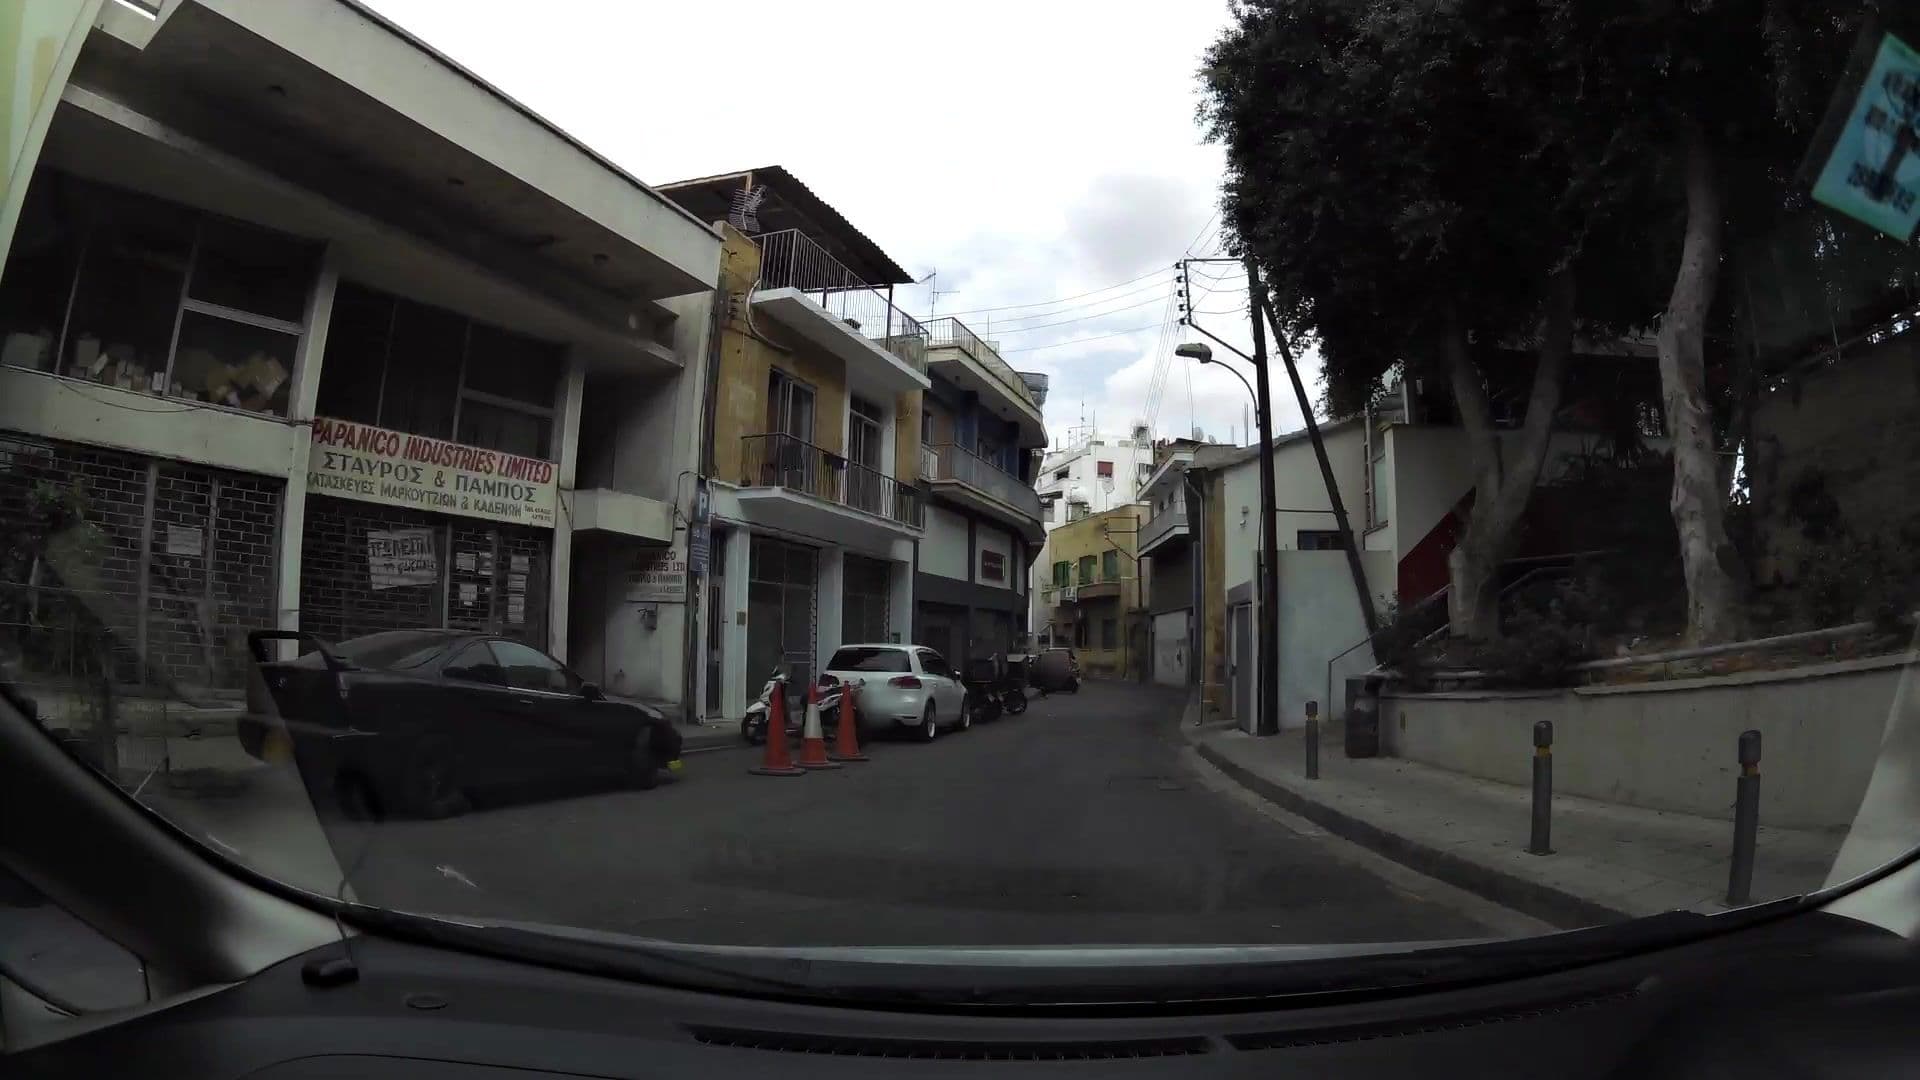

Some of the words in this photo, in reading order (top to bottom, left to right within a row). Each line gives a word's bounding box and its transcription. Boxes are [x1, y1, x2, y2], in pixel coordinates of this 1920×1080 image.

[312, 418, 400, 457] PAPANICO
[403, 435, 496, 475] INDUSTRIES
[498, 453, 552, 484] LIMITED
[323, 452, 423, 484] ΣΤΑΥΡΟΣ
[434, 470, 445, 487] &
[455, 475, 536, 503] ΠΑΜΠΟΣ
